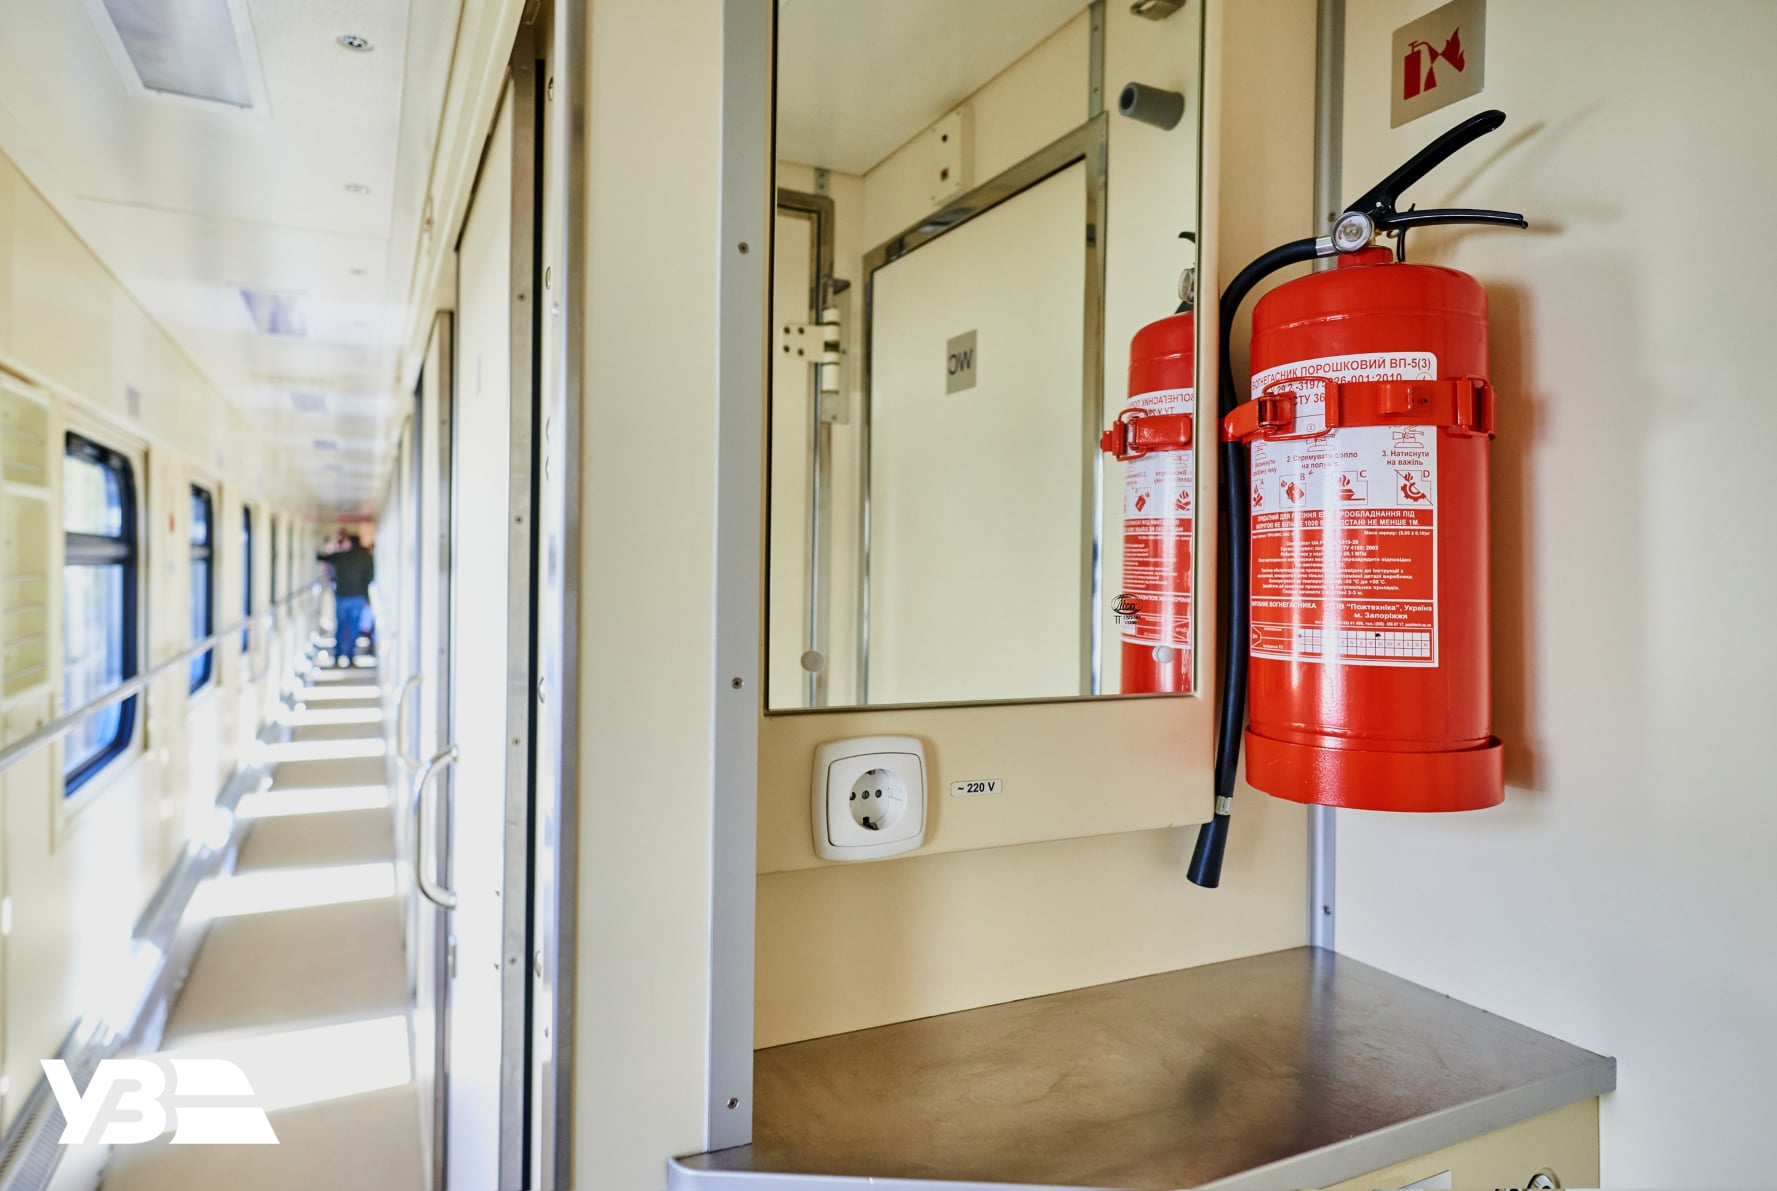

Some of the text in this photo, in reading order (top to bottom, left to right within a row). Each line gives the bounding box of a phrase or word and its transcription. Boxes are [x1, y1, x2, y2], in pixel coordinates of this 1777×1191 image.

[1252, 356, 1431, 391] ВОГНЕГАСНИК ПОРОШКОВИЙ ВП-5(3)
[1391, 450, 1430, 459] Натиснути
[1360, 470, 1367, 478] C
[1423, 470, 1430, 478] D
[1364, 611, 1408, 620] Запоріжжя
[967, 782, 985, 793] 220
[988, 781, 995, 792] V
